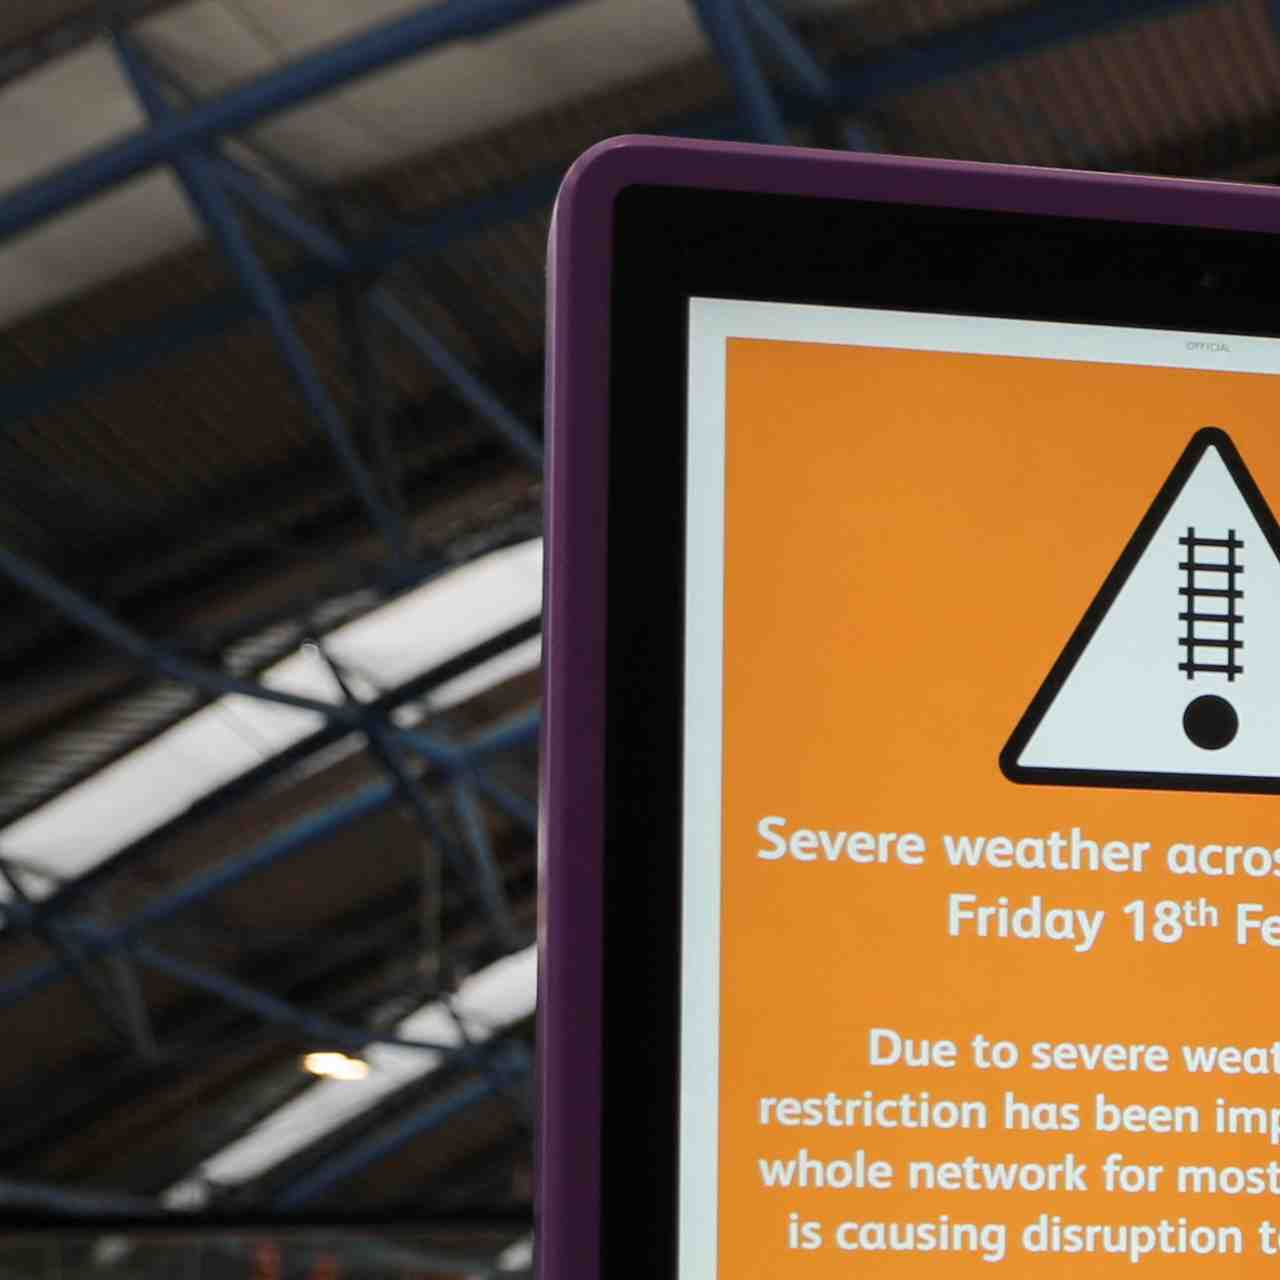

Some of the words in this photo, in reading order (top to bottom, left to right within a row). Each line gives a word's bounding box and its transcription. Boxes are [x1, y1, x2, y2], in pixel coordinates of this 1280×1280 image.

[757, 815, 928, 866] Severe
[943, 827, 1153, 873] weather
[948, 892, 1106, 953] Friday
[1123, 897, 1219, 945] 18th
[868, 1027, 958, 1068] Due
[970, 1034, 1019, 1070] to
[1031, 1041, 1170, 1073] severe
[759, 1090, 988, 1129] restriction
[1004, 1091, 1081, 1132] has
[1095, 1092, 1200, 1134] been
[758, 1148, 894, 1190] whole
[908, 1152, 1088, 1192] network
[1102, 1152, 1164, 1193] for
[788, 1212, 823, 1250] is
[835, 1215, 1008, 1263] causing
[1021, 1213, 1244, 1264] disruption
